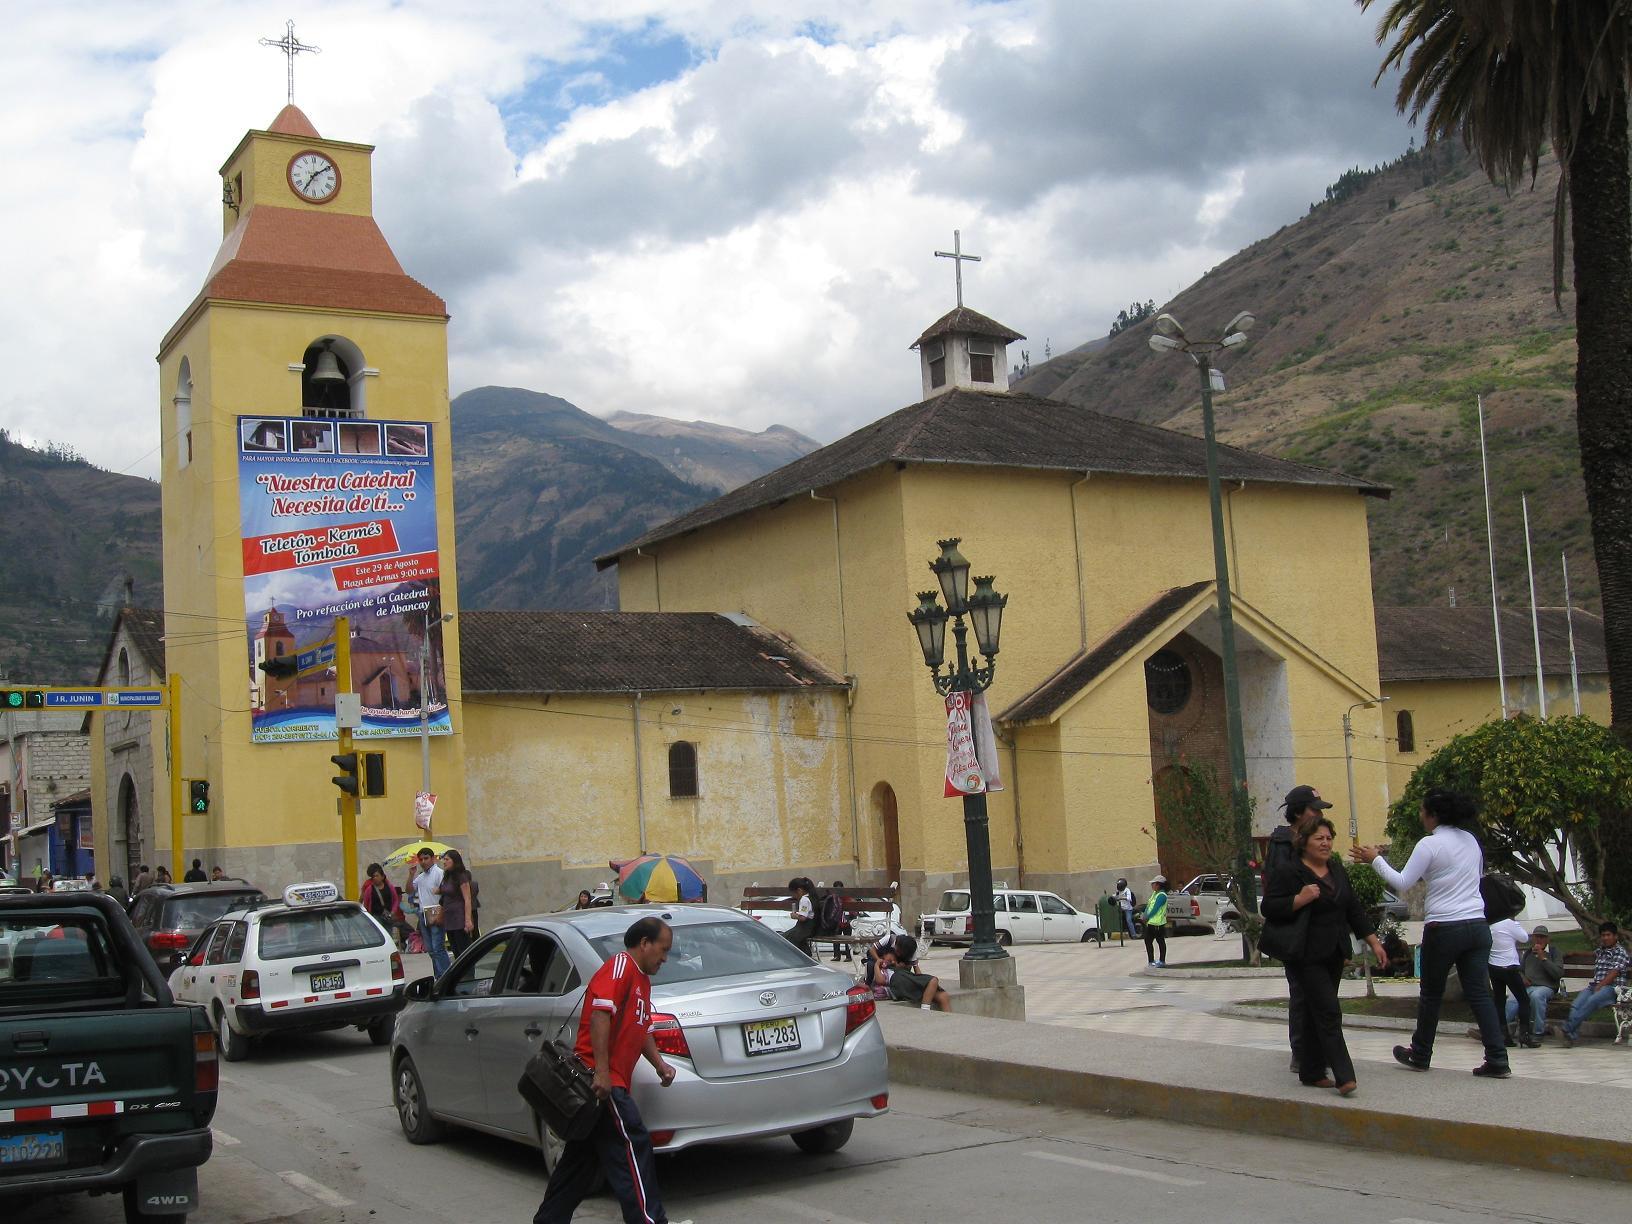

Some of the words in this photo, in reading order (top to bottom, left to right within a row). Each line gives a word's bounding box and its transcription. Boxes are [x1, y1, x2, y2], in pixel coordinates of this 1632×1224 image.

[339, 469, 416, 491] Catedral
[272, 494, 347, 516] Necesita
[348, 493, 372, 513] de
[260, 533, 315, 554] Teletón
[328, 522, 382, 543] Kermés
[294, 543, 358, 565] Tómbola
[343, 580, 363, 588] Plaza
[376, 573, 398, 582] Armas
[400, 569, 417, 578] 9:00
[419, 567, 435, 575] a.m.
[355, 567, 370, 576] Este
[372, 564, 382, 573] 29
[384, 562, 393, 570] de
[394, 559, 419, 570] Agosto
[296, 609, 313, 619] Pro
[316, 601, 360, 616] refacción
[362, 598, 374, 607] de
[376, 595, 387, 605] la
[389, 587, 429, 603] Catedral
[376, 607, 388, 617] de
[390, 600, 430, 615] Abancay
[70, 695, 94, 703] JUNIN
[747, 1024, 797, 1049] F4L-283
[147, 1195, 189, 1205] 4WD
